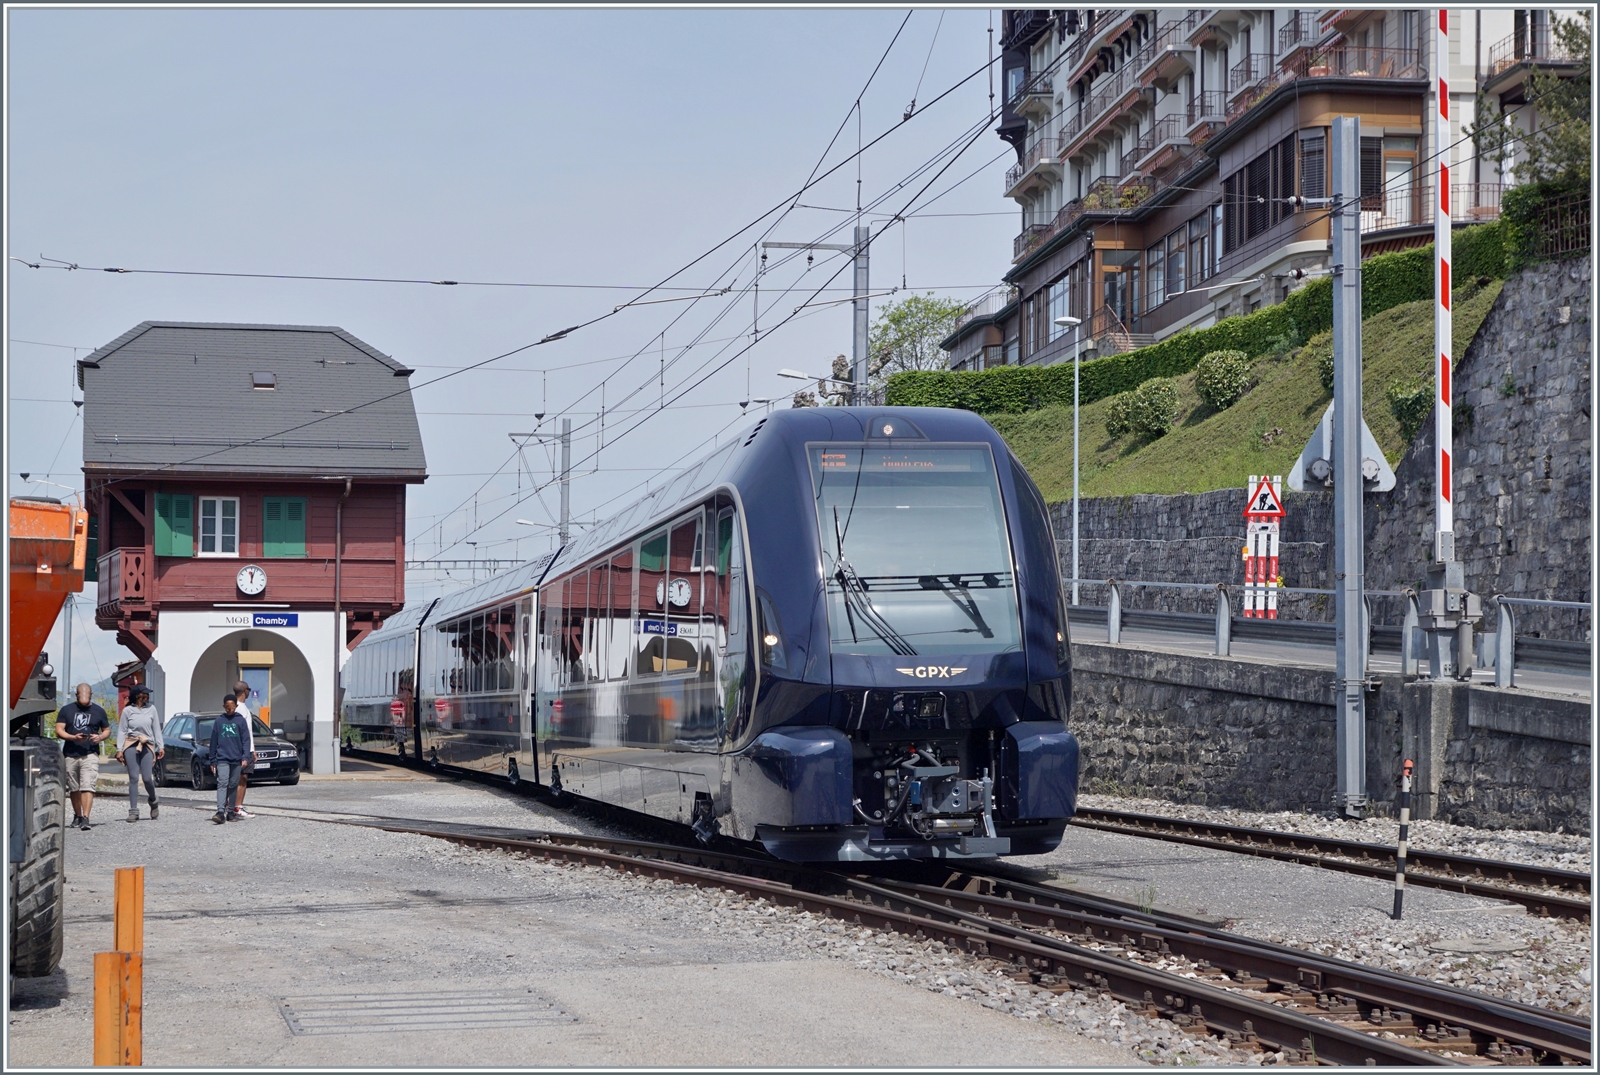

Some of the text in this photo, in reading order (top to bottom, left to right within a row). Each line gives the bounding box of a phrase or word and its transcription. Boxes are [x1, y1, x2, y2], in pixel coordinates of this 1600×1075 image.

[225, 616, 249, 624] MOB
[255, 617, 288, 625] Chamby
[915, 666, 950, 678] GPX
